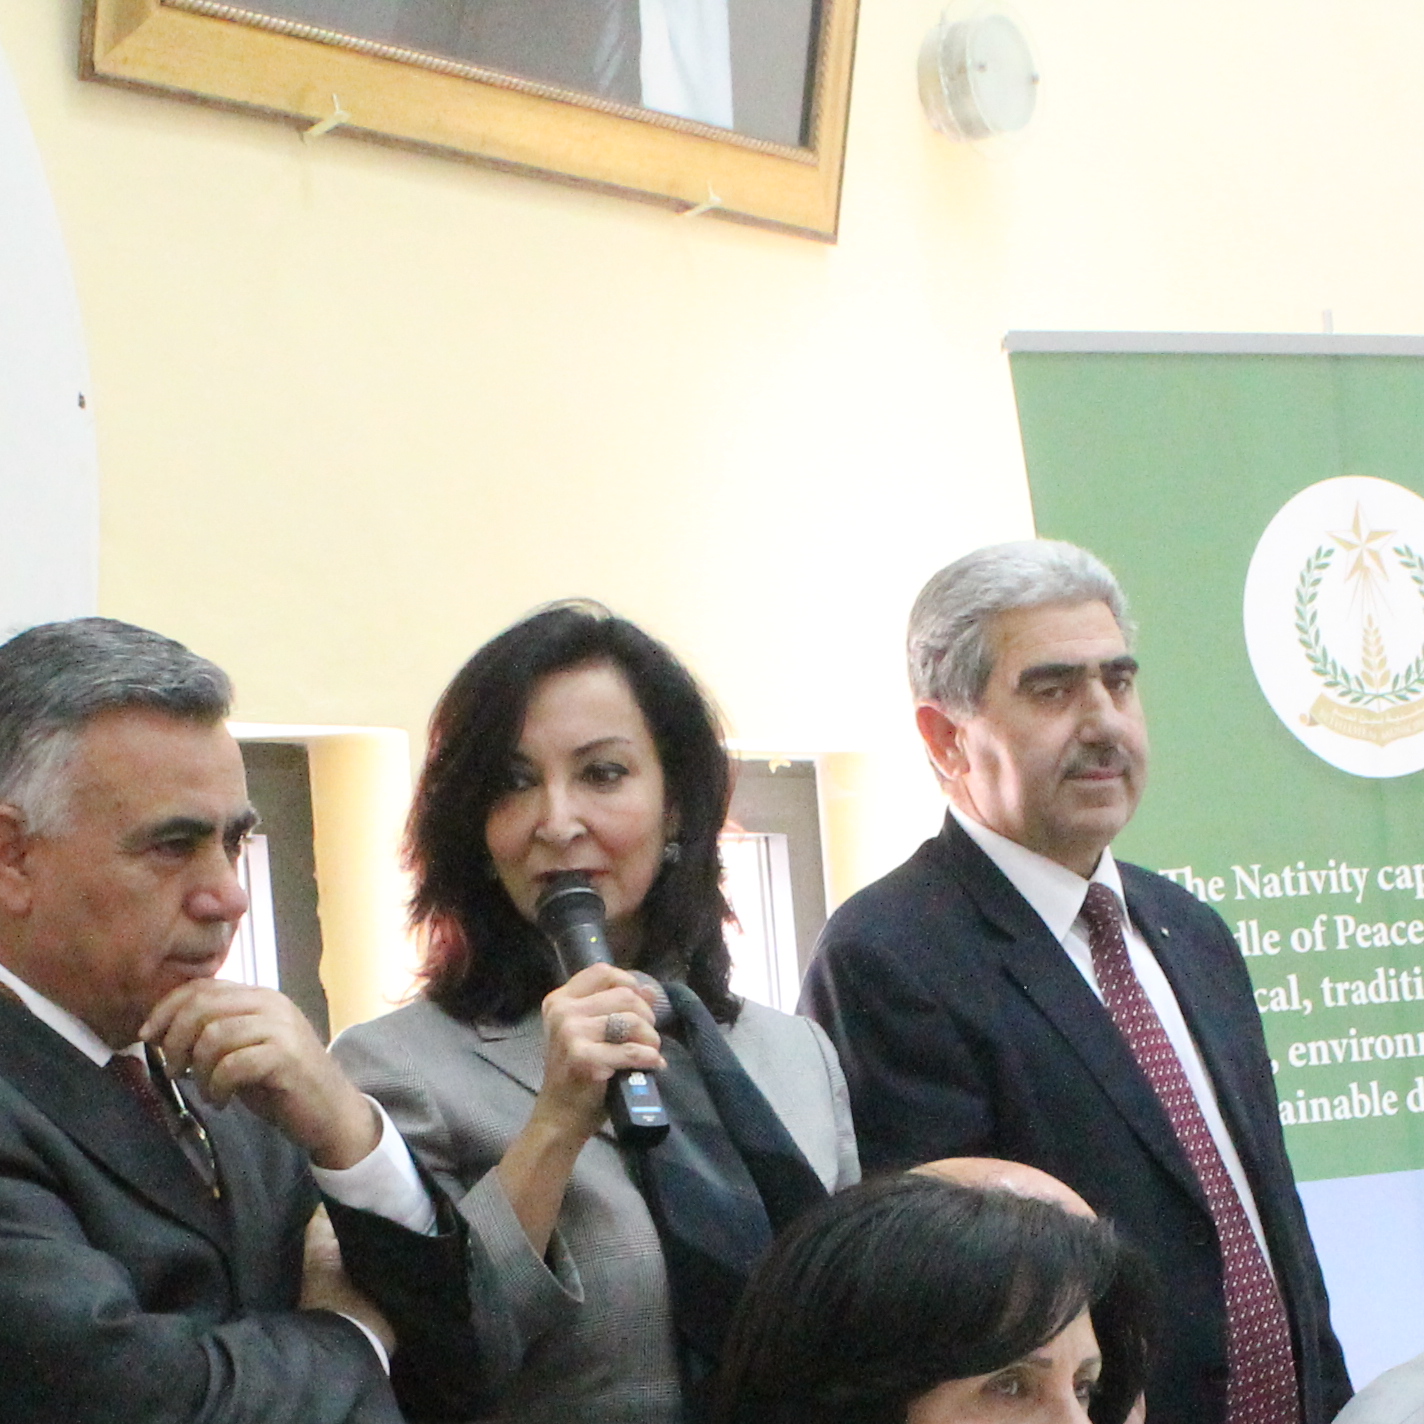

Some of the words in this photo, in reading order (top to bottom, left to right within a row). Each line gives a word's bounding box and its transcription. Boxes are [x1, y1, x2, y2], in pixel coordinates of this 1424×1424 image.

[1230, 859, 1369, 903] Nativity
[1232, 919, 1282, 957] dle
[1290, 914, 1327, 953] of
[1254, 973, 1313, 1015] cal,
[1278, 1080, 1399, 1126] ainable
